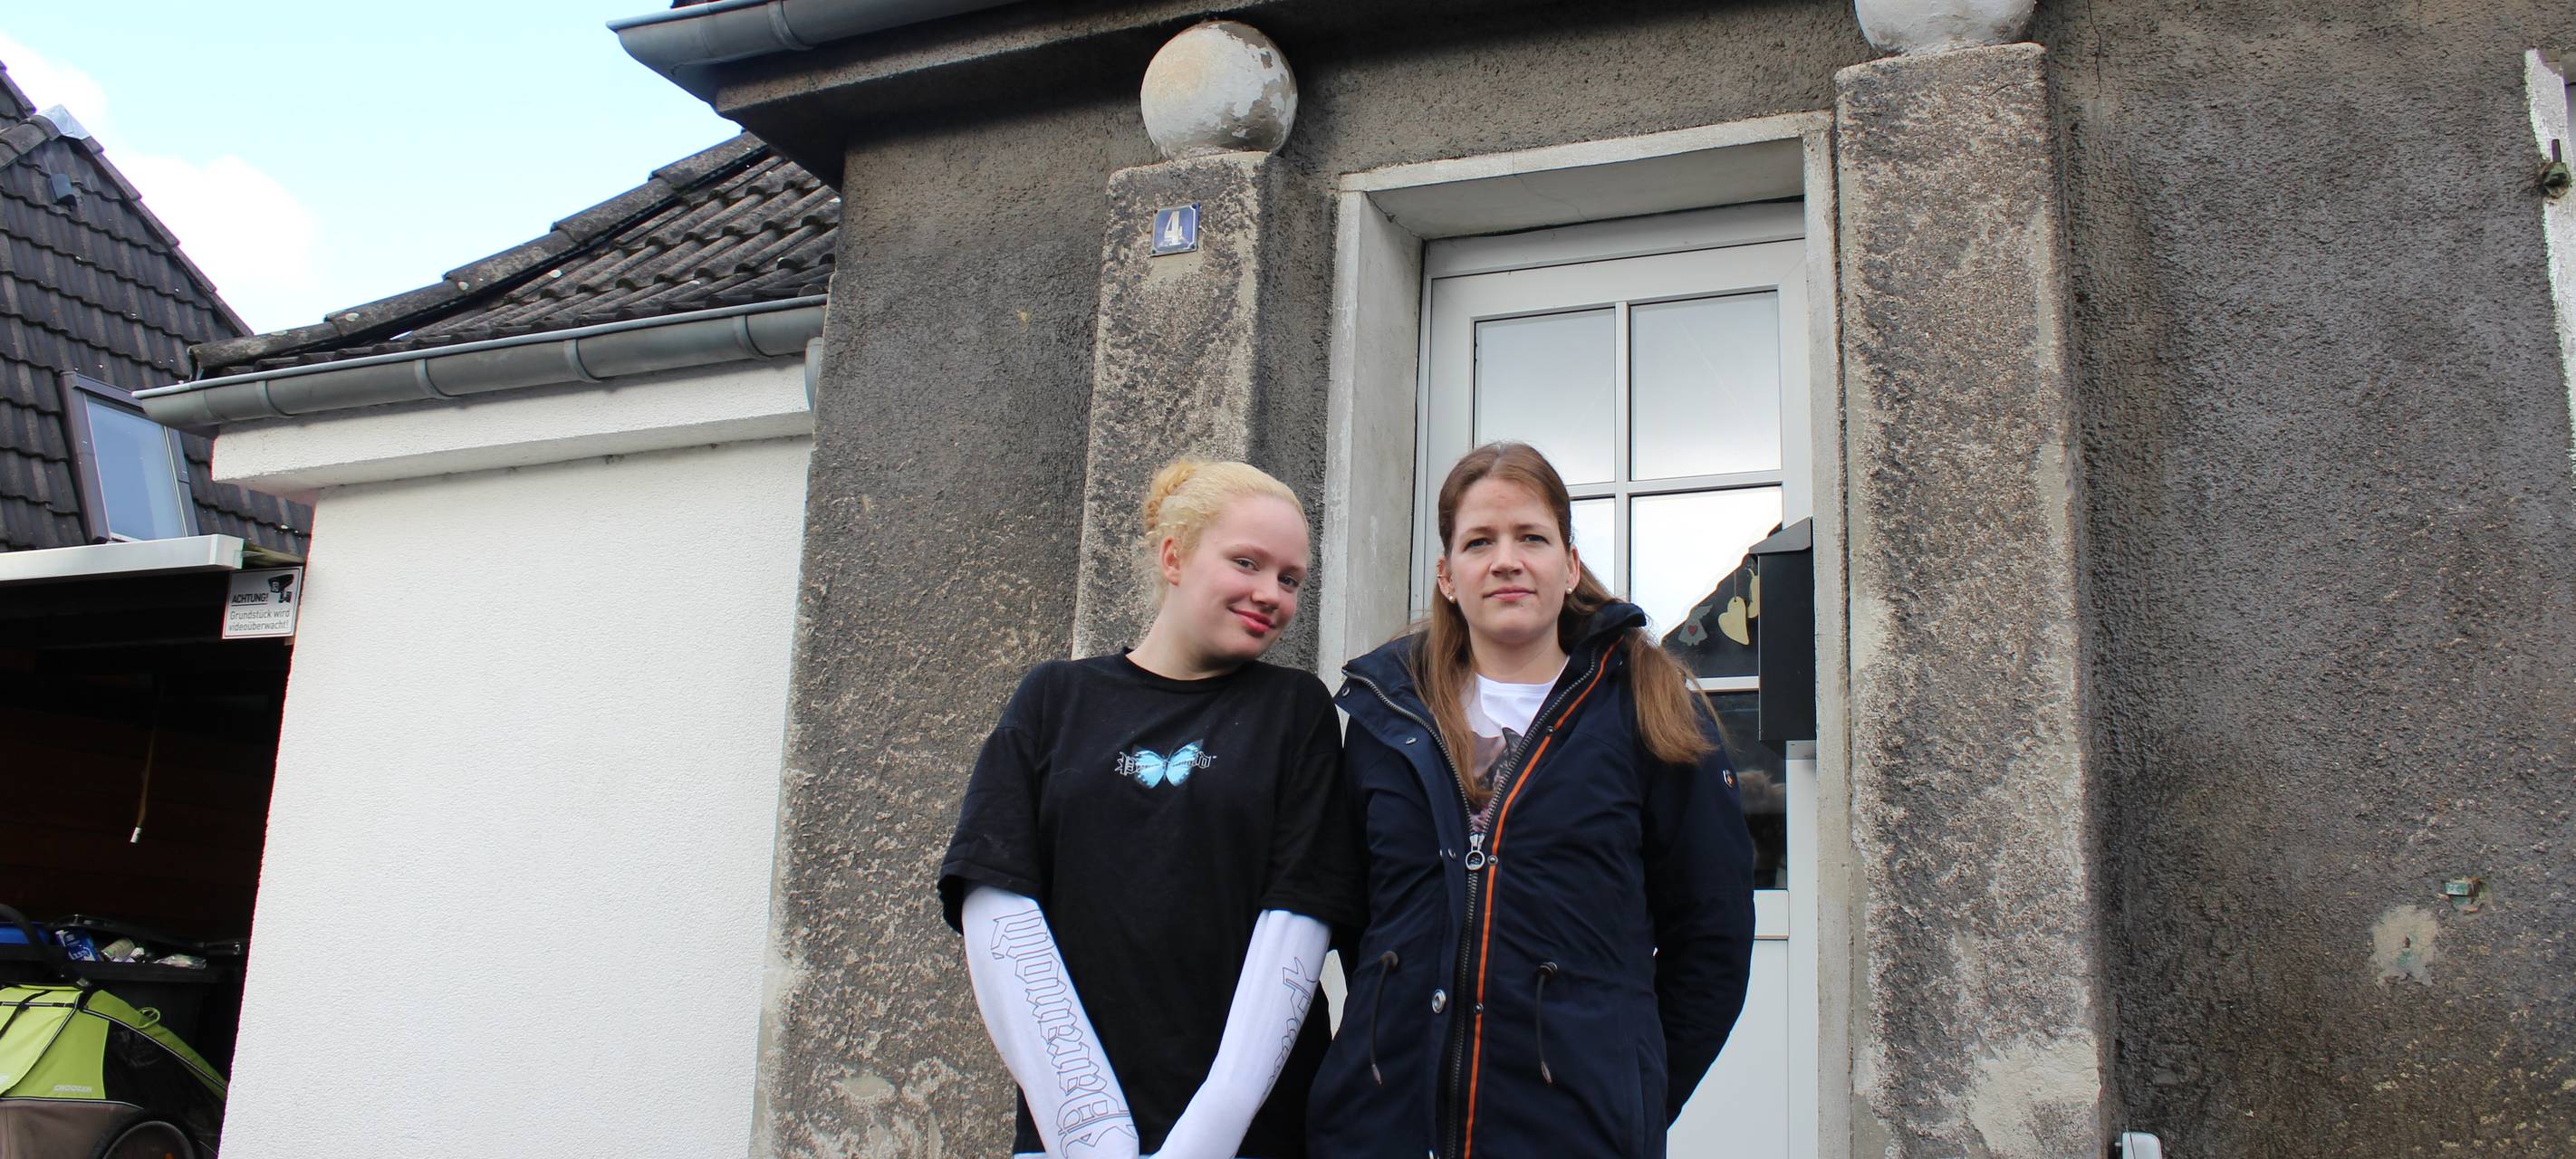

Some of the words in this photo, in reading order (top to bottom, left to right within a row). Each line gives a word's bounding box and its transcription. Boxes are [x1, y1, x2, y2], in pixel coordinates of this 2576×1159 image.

[1163, 210, 1183, 245] 4
[232, 593, 268, 603] ACHTUNG!
[230, 609, 272, 619] Grundstück
[274, 608, 290, 618] wird
[229, 620, 289, 631] videoüberwacht!
[990, 908, 1139, 1159] Paranoid
